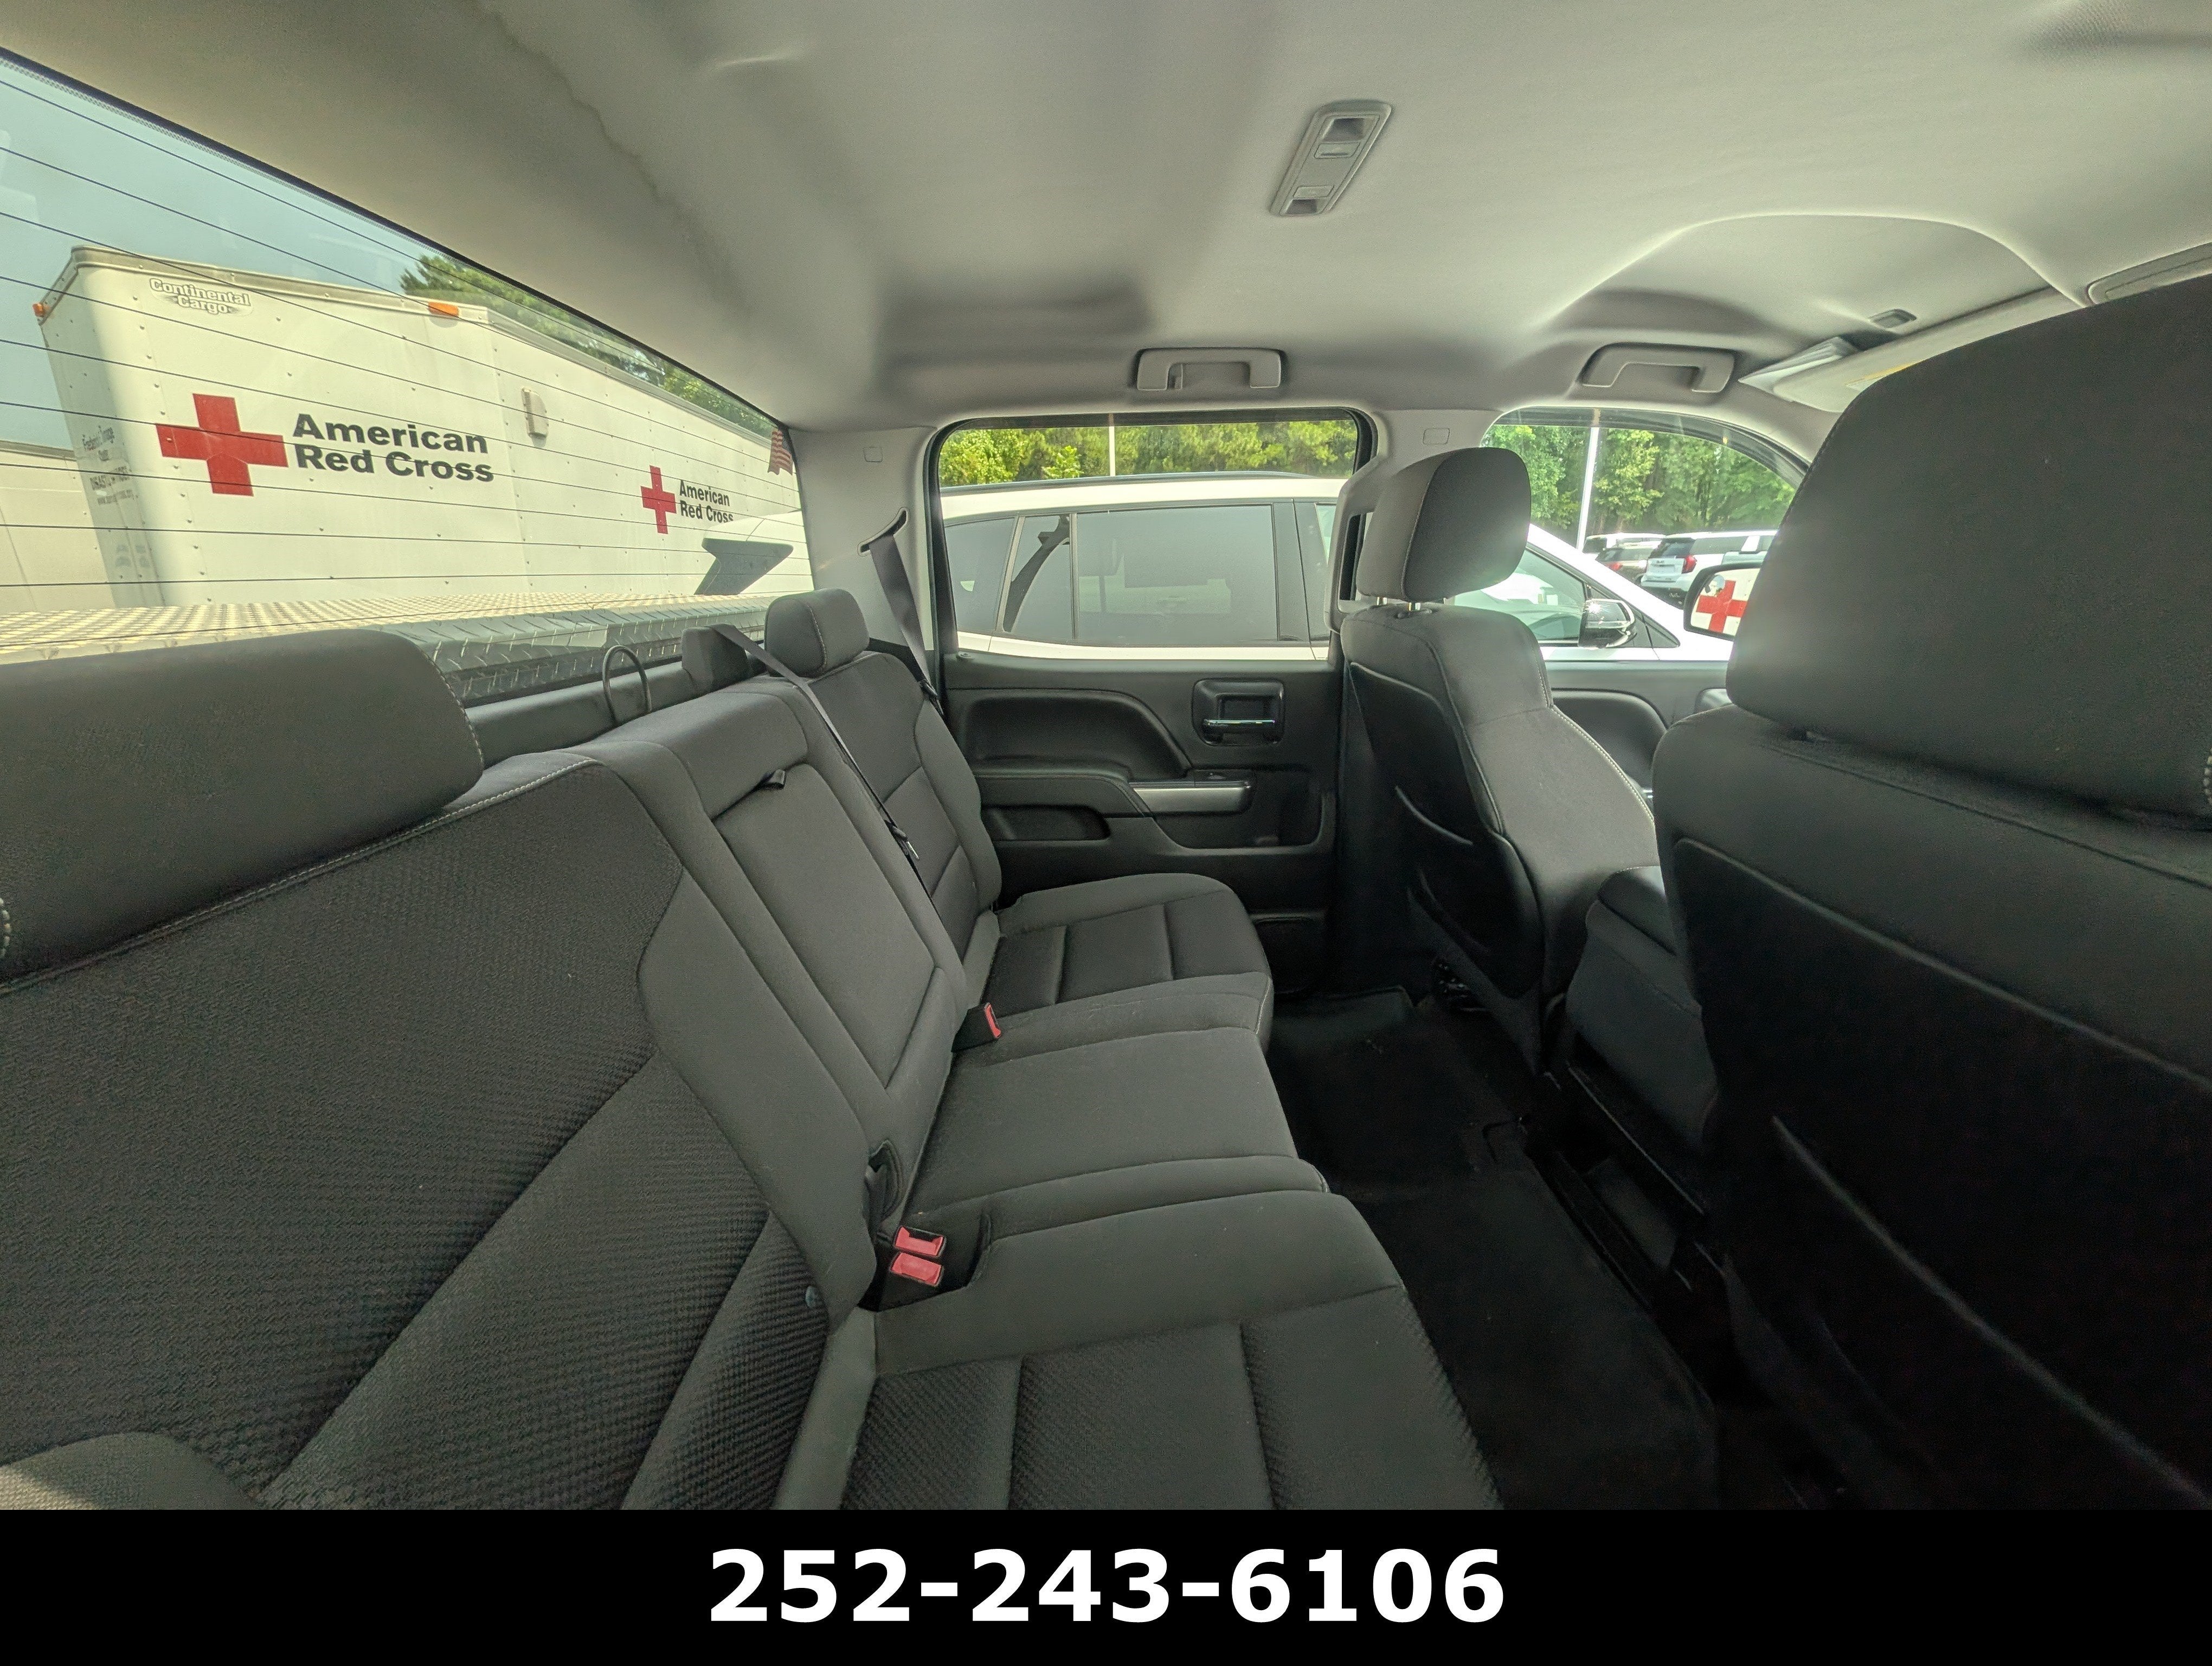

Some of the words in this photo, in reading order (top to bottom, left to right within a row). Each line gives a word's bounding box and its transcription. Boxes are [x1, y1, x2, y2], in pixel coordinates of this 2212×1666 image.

[150, 278, 252, 306] Continental
[177, 294, 229, 315] Cargo
[293, 413, 488, 454] American
[294, 444, 375, 473] Red
[385, 451, 494, 482] Cross
[679, 479, 730, 507] American
[680, 500, 703, 520] Red
[706, 505, 734, 523] Cross
